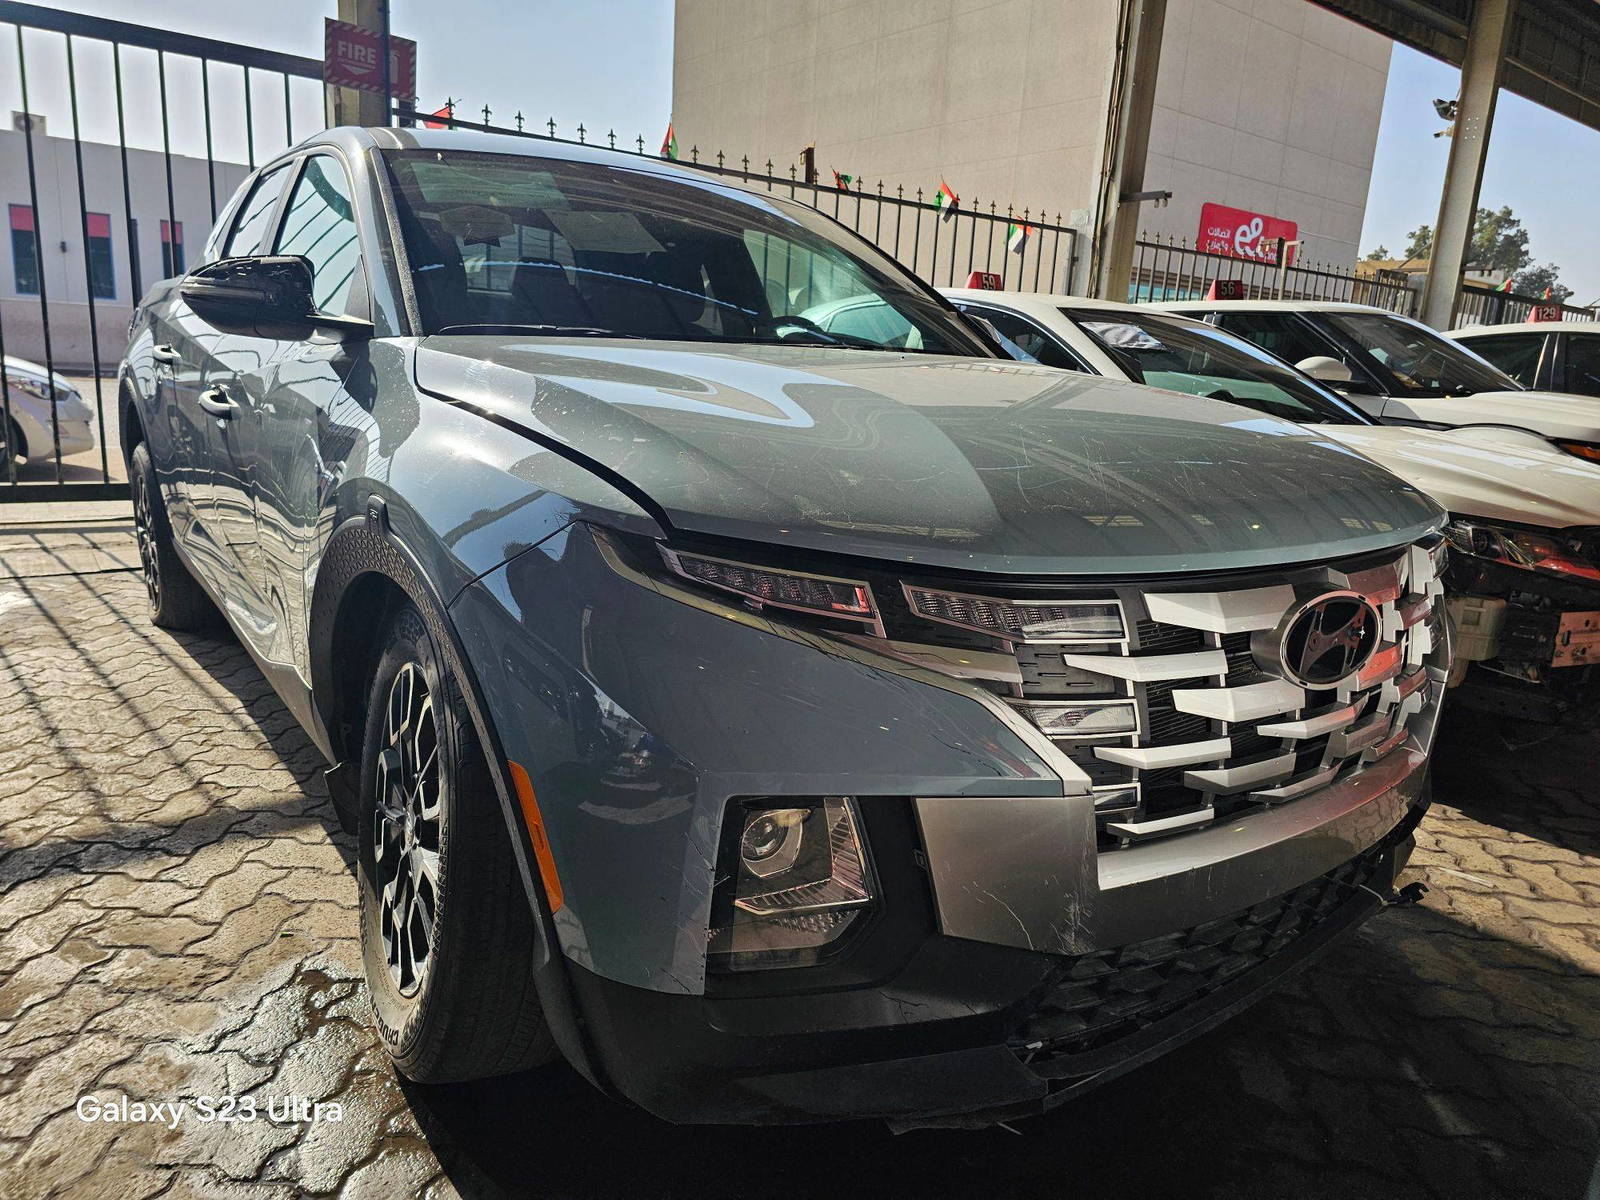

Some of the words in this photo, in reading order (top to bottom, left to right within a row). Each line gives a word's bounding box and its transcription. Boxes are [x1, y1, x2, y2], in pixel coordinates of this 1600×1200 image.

[337, 40, 377, 65] FIRE
[982, 274, 996, 290] 59
[1220, 281, 1236, 296] 56
[1538, 307, 1556, 321] 129
